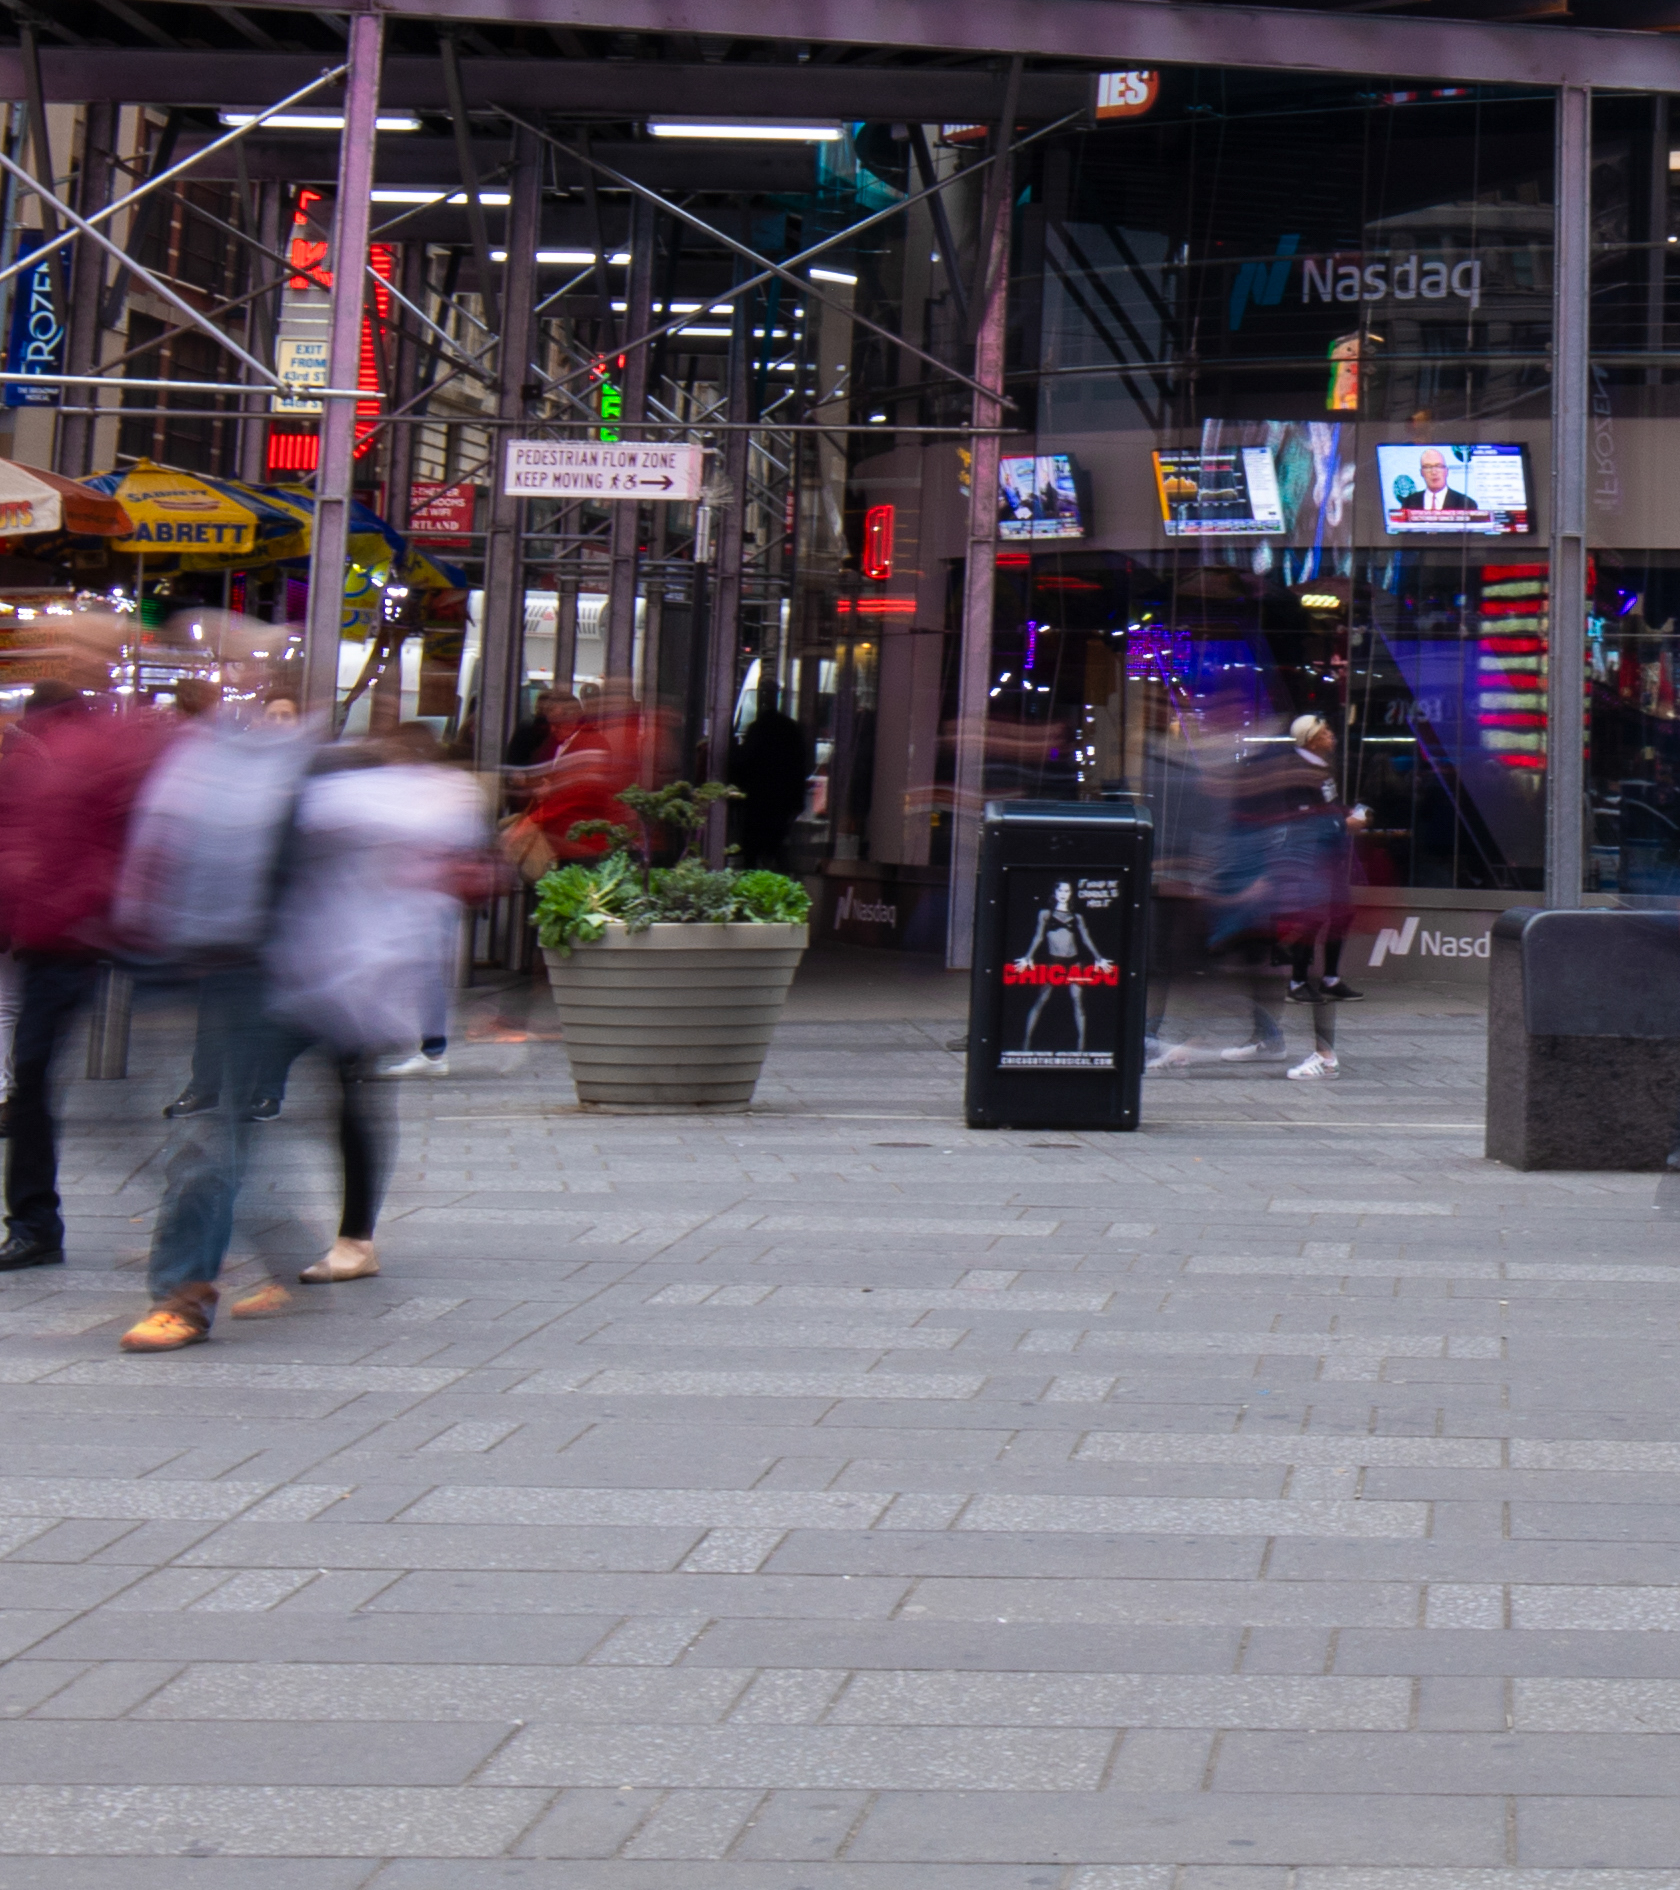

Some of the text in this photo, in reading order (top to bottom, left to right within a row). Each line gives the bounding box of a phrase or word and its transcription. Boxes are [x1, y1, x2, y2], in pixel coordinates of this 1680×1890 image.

[1302, 256, 1482, 308] Nasdaq
[296, 344, 322, 355] EXIT
[291, 357, 326, 368] FROM
[283, 370, 309, 382] 43rd
[517, 448, 677, 469] PEDESTRIAN FLOW ZONE
[515, 471, 604, 489] KEEP MOVING
[411, 519, 460, 531] RTLAND
[1421, 931, 1492, 960] Nasd
[1003, 963, 1120, 986] CHICAGO
